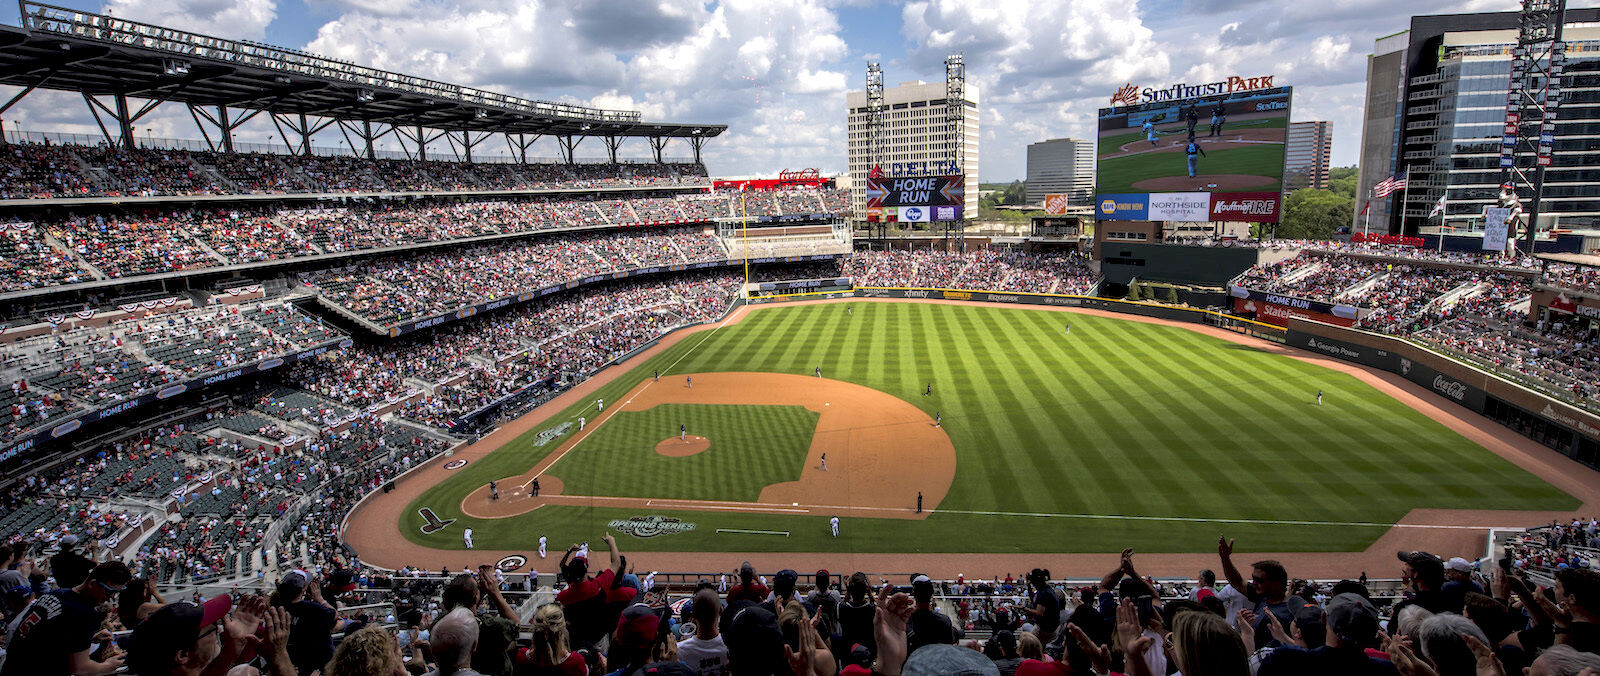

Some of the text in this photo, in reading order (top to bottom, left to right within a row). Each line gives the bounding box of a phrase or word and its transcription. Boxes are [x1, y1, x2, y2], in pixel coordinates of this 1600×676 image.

[893, 161, 961, 175] DELTA
[893, 178, 937, 191] HOME
[899, 190, 930, 203] RUN
[1242, 201, 1275, 217] TIRE
[904, 290, 929, 299] xfinity
[1265, 294, 1310, 309] HOME RUN
[297, 346, 327, 359] HOME RUN
[1317, 342, 1360, 358] Georgia Power
[203, 370, 242, 385] HOME RUN
[99, 400, 139, 419] HOME RUN
[17, 439, 34, 452] RUN
[608, 520, 697, 531] OPENING SERIES
